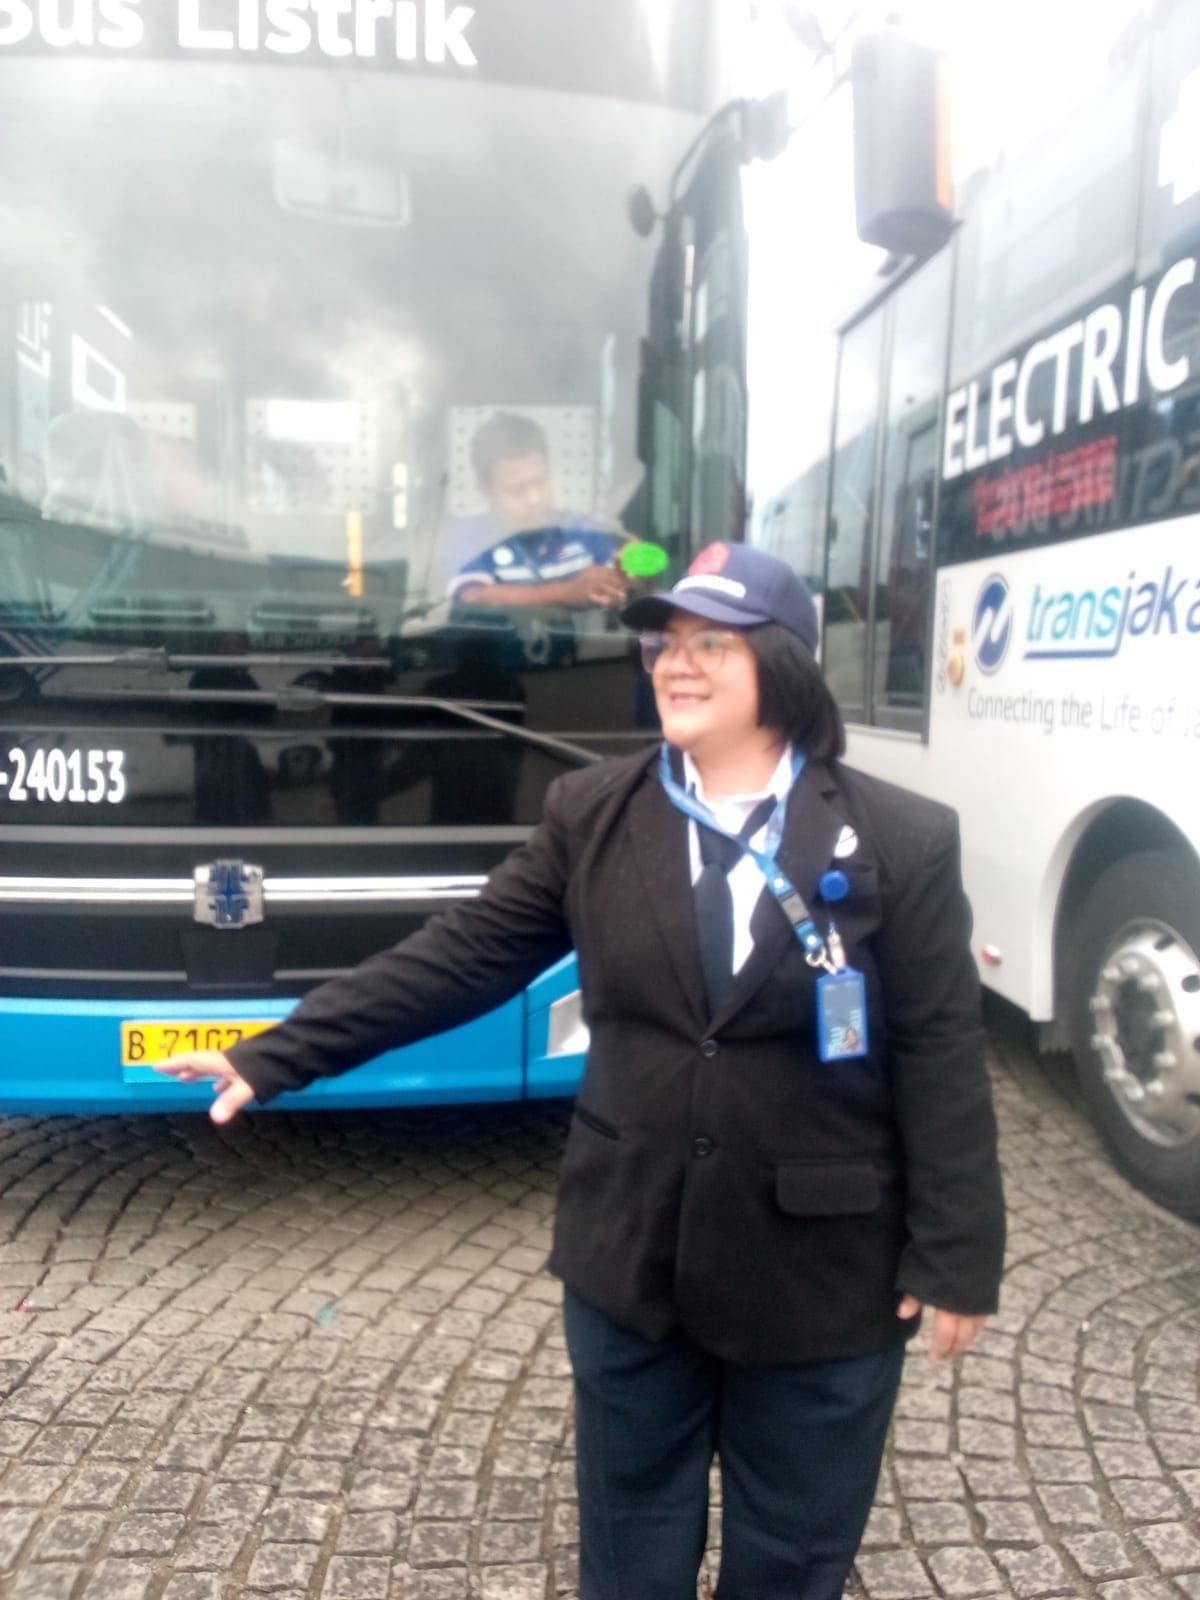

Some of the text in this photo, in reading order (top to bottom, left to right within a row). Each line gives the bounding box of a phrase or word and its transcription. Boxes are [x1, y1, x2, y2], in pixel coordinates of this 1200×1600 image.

[178, 0, 478, 65] Listrik
[943, 257, 1196, 480] ELECTRIC
[967, 686, 1054, 736] Connecting
[1060, 692, 1093, 729] the
[1100, 691, 1142, 733] Life
[128, 1030, 145, 1061] B
